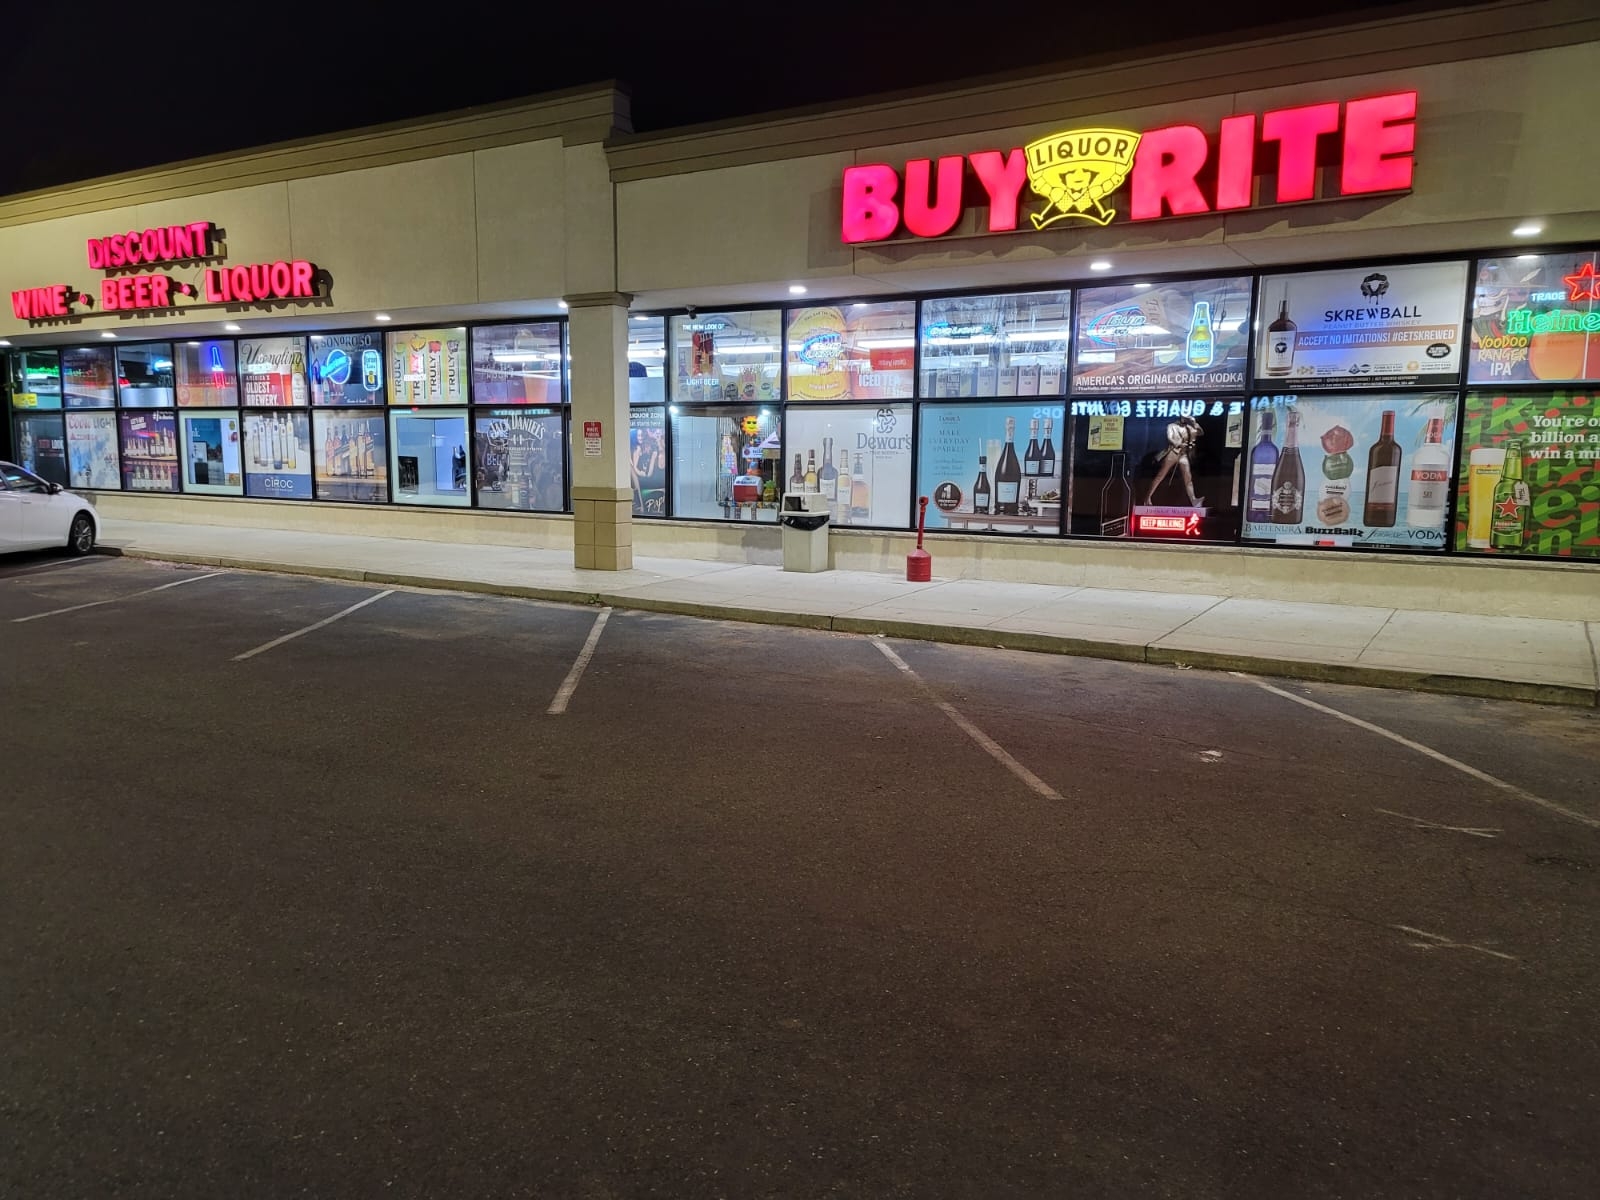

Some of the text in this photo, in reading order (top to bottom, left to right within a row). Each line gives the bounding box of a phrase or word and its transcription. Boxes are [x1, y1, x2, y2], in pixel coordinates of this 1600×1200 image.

[1035, 136, 1129, 166] LIQUOR
[842, 91, 1418, 244] BUY RITE
[87, 221, 210, 270] DISCOUNT
[11, 260, 313, 319] WINE BEER LIQUOR
[1531, 291, 1566, 302] TRADE
[1324, 305, 1422, 322] SKREWBALL
[704, 323, 717, 331] LOOK
[1299, 329, 1454, 346] ACCEPT NO IMITATIONS! #GETSKREWED
[1478, 335, 1528, 349] VOODOO
[1478, 349, 1527, 361] RANGER
[1490, 362, 1512, 376] IPA
[1076, 373, 1244, 386] AMERICA'S ORIGINAL CRAFT VODKA
[246, 382, 270, 393] OLDEST
[511, 413, 545, 440] DANIEL'S
[1533, 416, 1600, 427] You're o
[857, 433, 912, 449] Dewar's
[1531, 432, 1584, 443] billion
[1530, 449, 1560, 459] win
[1565, 451, 1574, 459] a
[1415, 472, 1442, 480] VODA
[1142, 519, 1184, 529] KEEP WALKING
[1305, 526, 1364, 537] BuzzBallz
[1407, 530, 1444, 540] VODA
